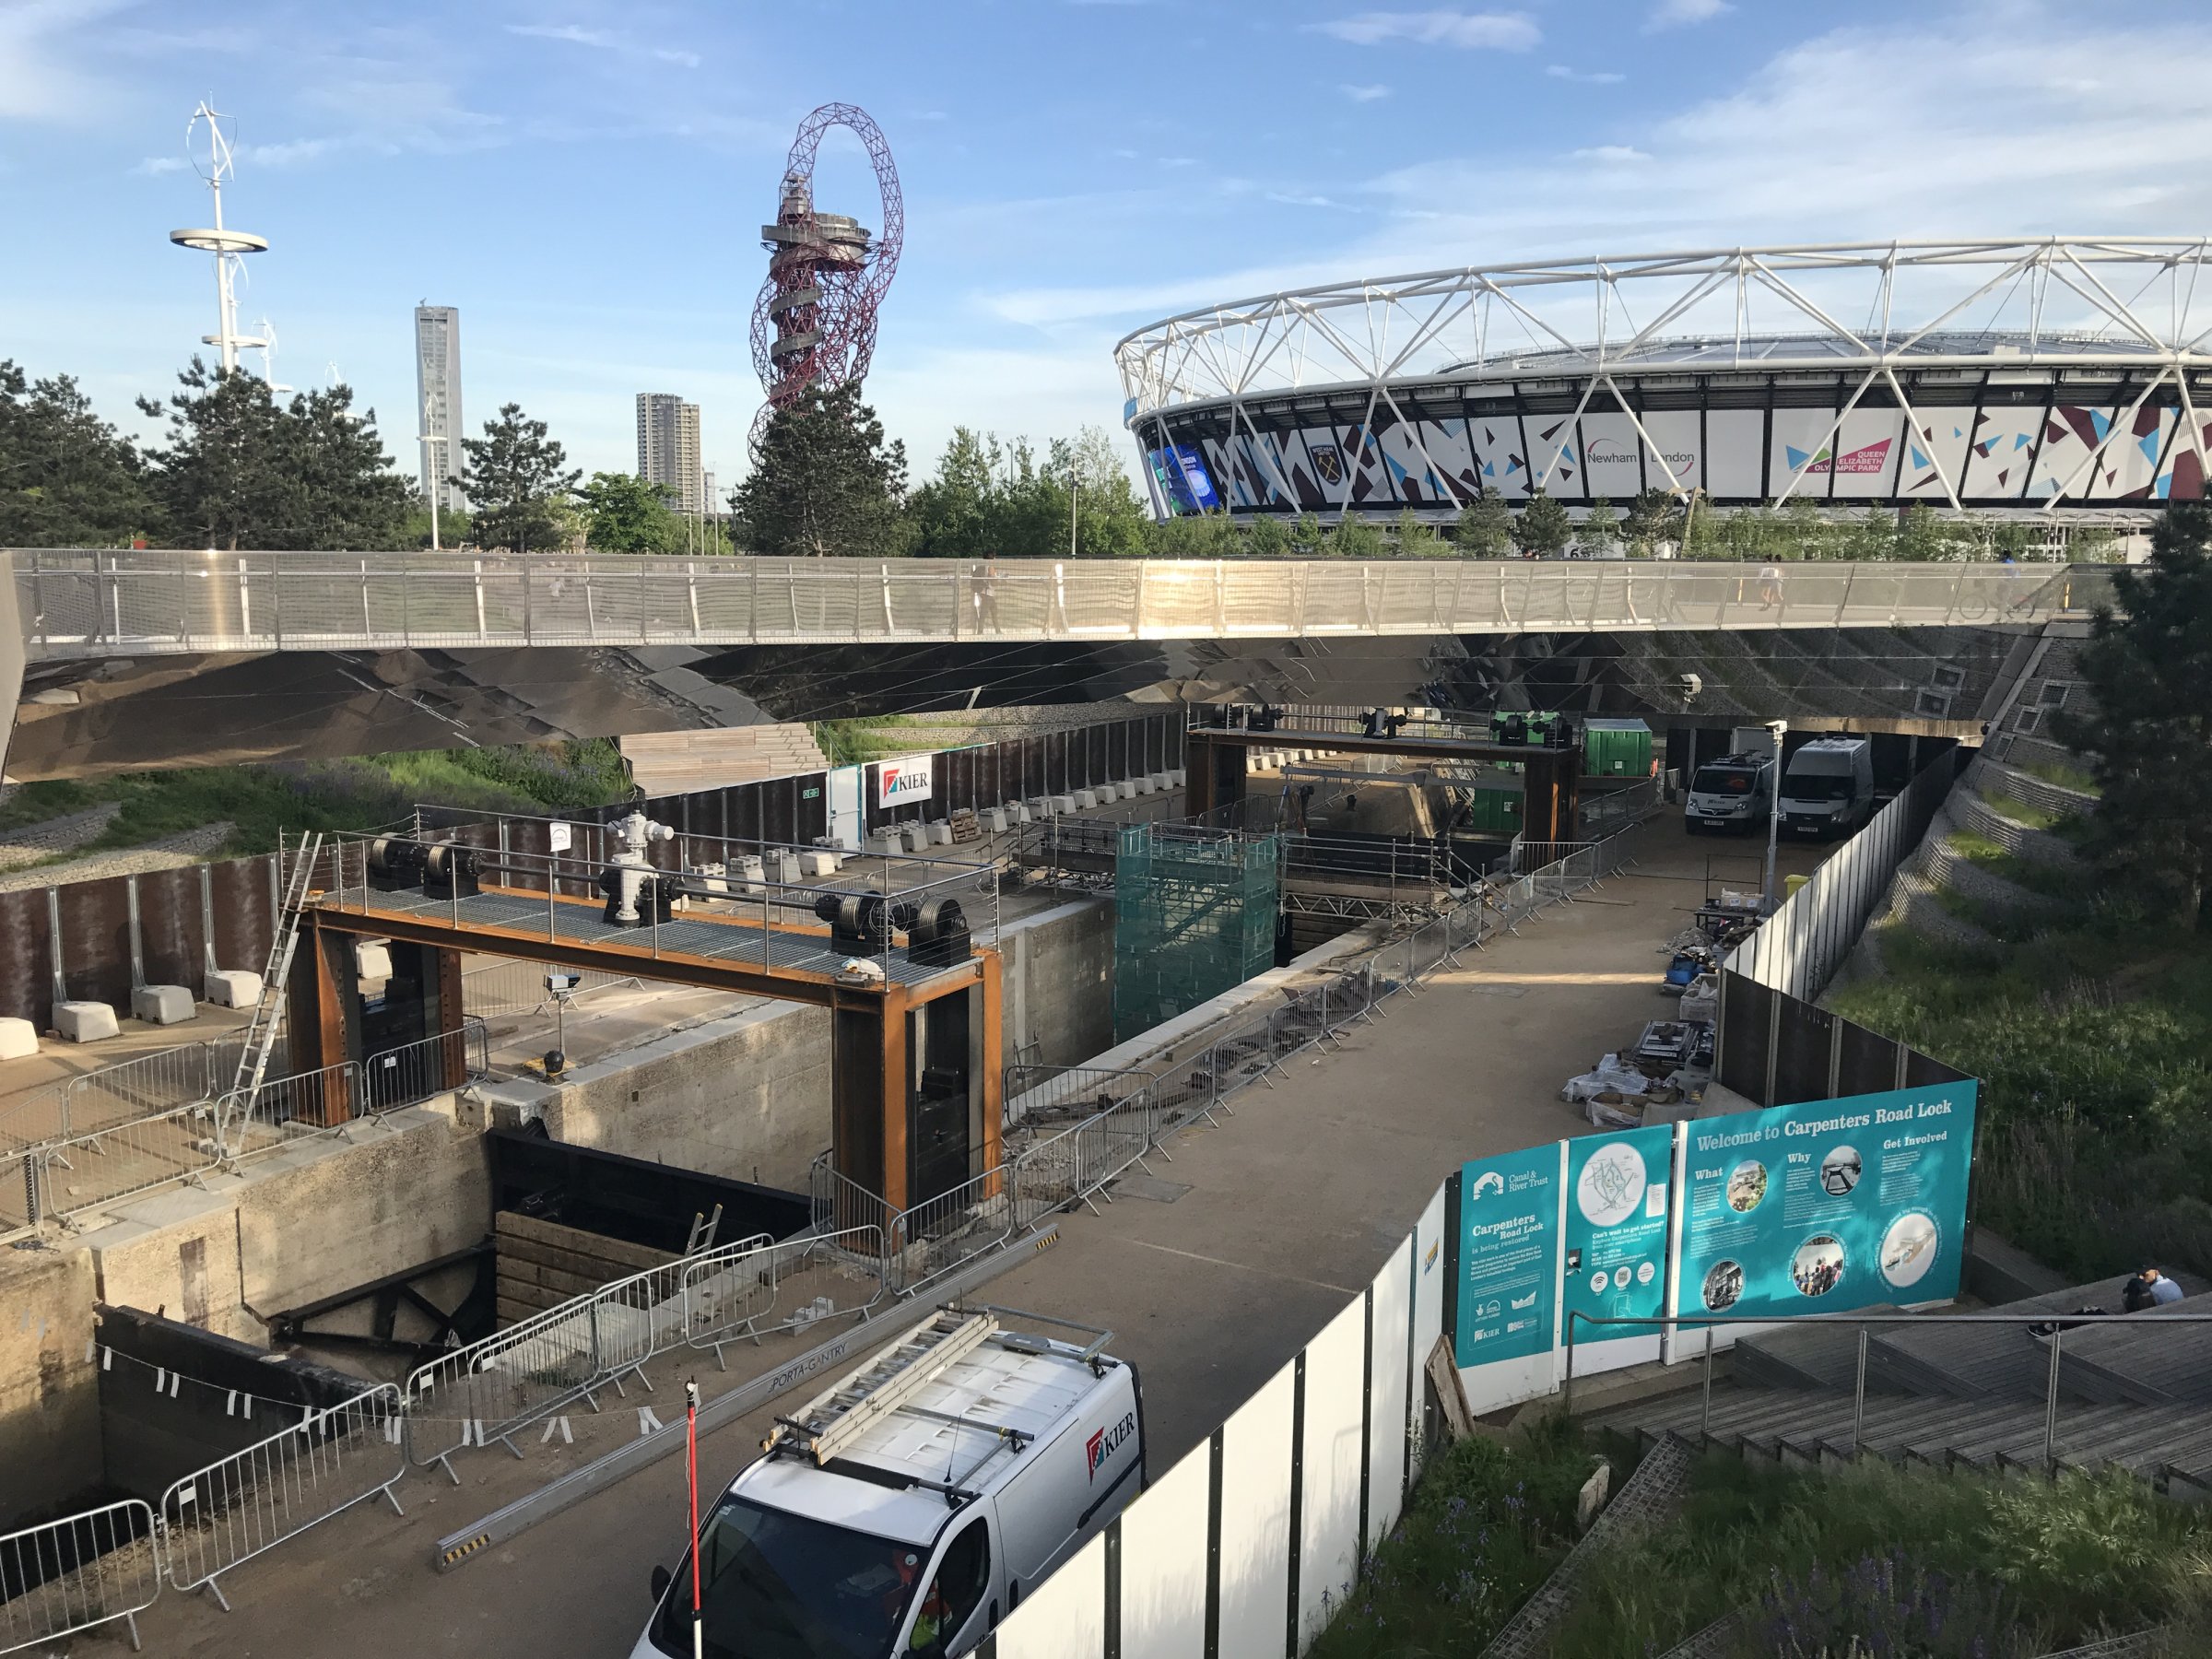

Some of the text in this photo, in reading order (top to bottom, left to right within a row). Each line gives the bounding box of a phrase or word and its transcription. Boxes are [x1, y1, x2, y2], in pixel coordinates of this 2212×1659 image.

[1587, 453, 1637, 464] Newham
[1857, 451, 1886, 459] QUEEN
[900, 772, 928, 792] KIER
[1696, 1099, 1953, 1152] Welcome to Carpenters Road Lock
[1883, 1130, 1947, 1149] Get Involved
[1787, 1152, 1812, 1164] Why
[1508, 1170, 1537, 1183] Canal &
[1695, 1167, 1724, 1181] What
[1508, 1176, 1548, 1193] River Trust
[1472, 1214, 1535, 1237] Carpenters
[1500, 1222, 1544, 1241] Road Lock
[1480, 1241, 1500, 1253] being
[1500, 1234, 1530, 1247] restored
[1482, 1327, 1500, 1339] KIER
[772, 1342, 848, 1390] PORTA-GANTRY
[1103, 1411, 1135, 1459] KIER
